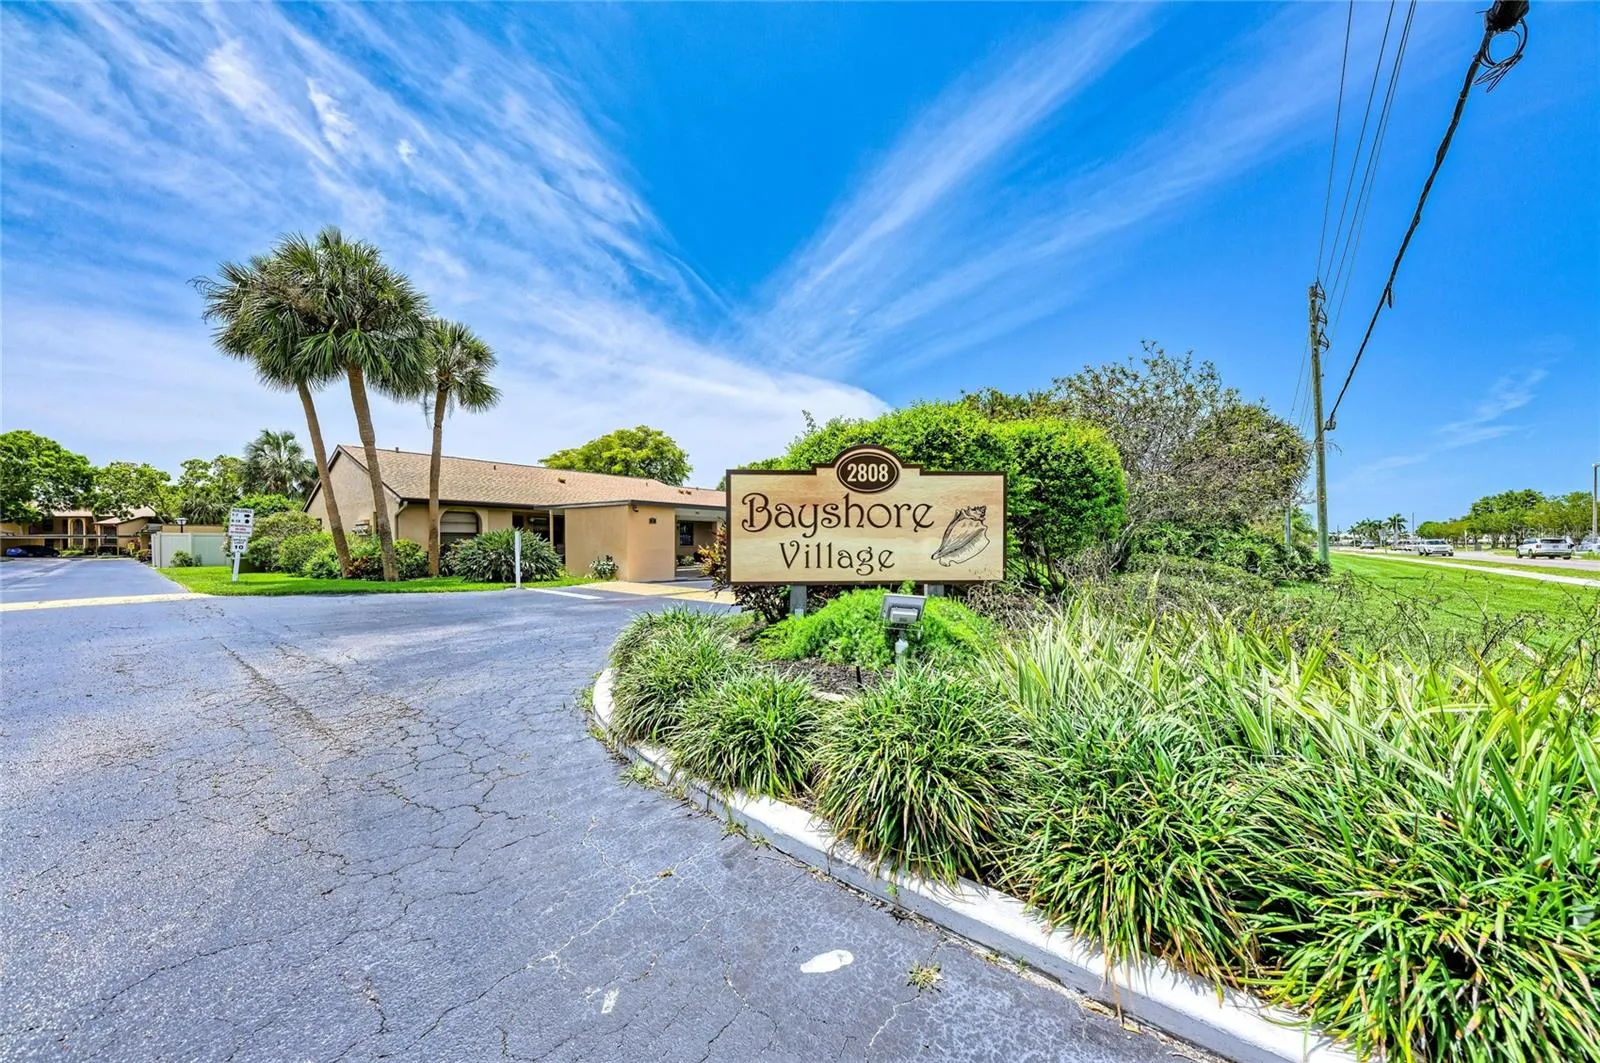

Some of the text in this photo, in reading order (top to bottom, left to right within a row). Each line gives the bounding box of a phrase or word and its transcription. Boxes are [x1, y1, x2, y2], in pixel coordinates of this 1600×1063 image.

[847, 463, 889, 482] 2808
[741, 492, 935, 538] Bayshore
[779, 540, 896, 576] Village
